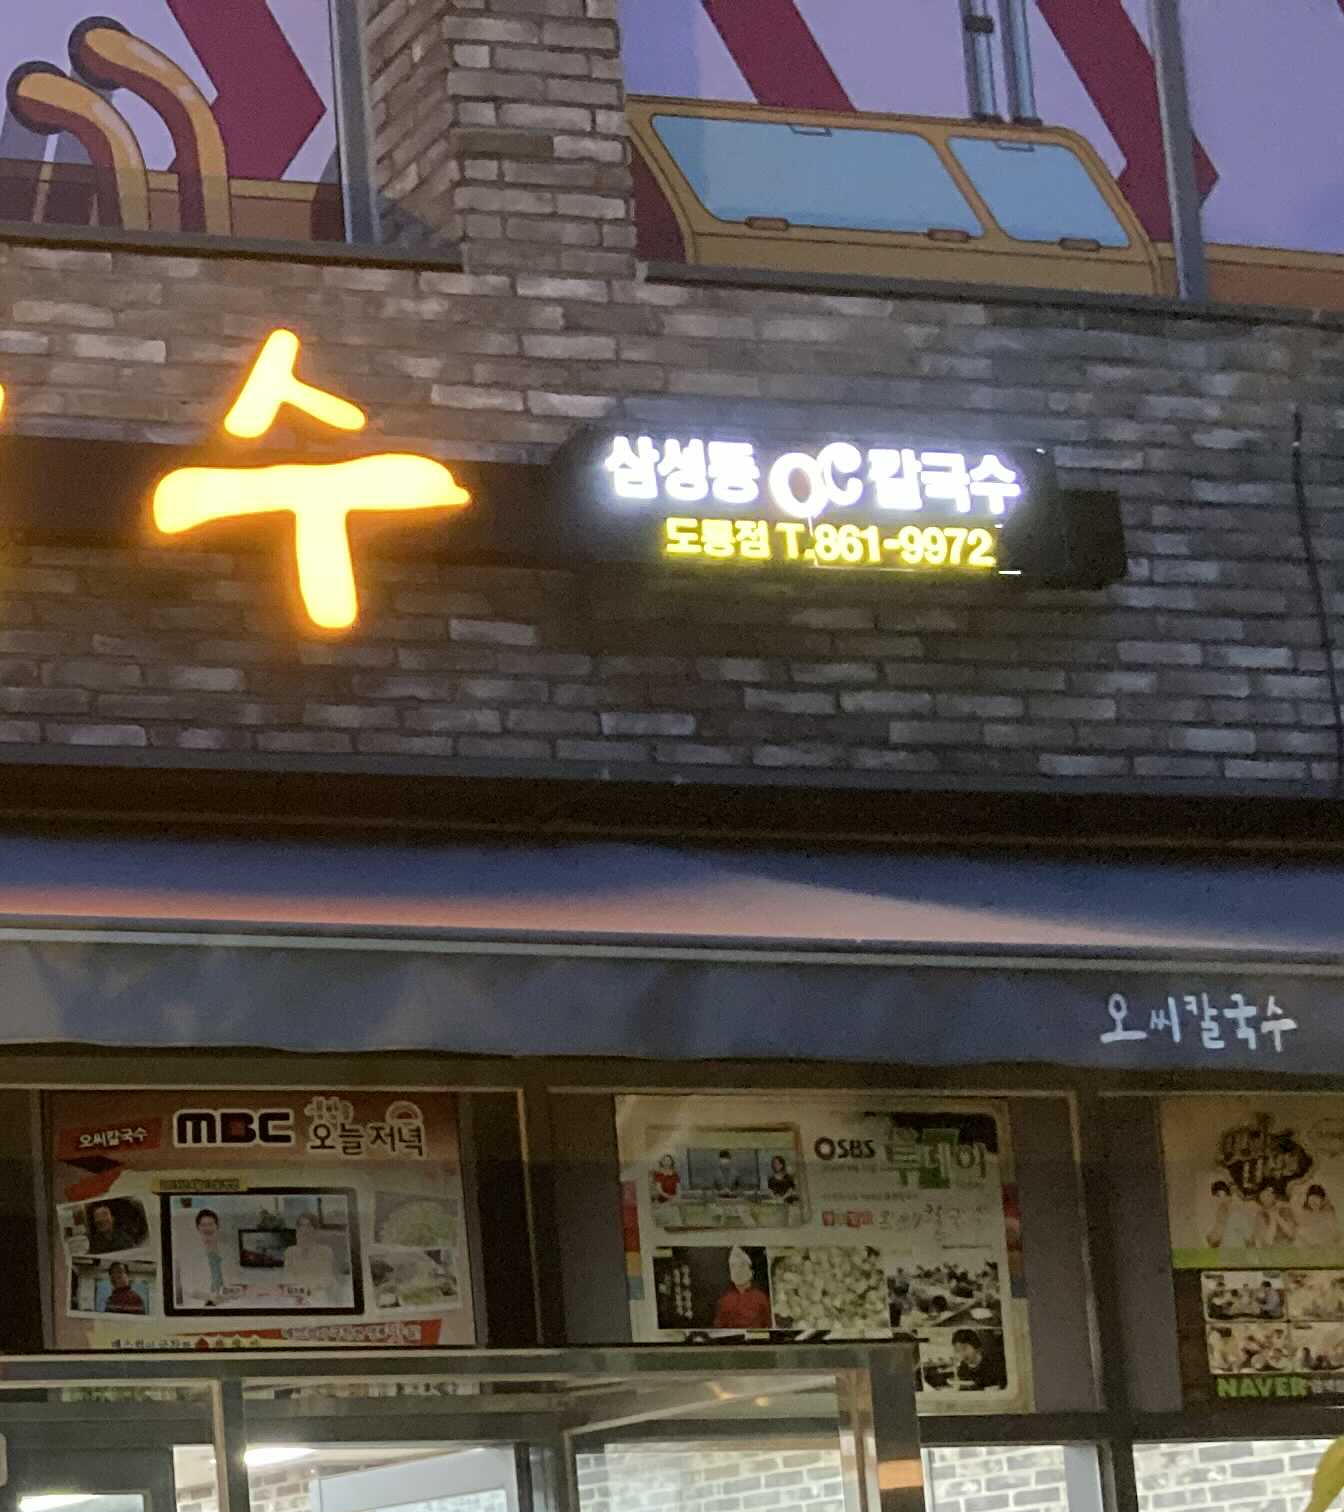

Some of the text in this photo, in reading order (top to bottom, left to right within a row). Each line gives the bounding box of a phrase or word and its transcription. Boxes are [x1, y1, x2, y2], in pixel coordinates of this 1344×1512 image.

[604, 436, 761, 504] 삼성동
[775, 522, 998, 568] T.861-9972
[1100, 992, 1298, 1053] 오씨칼국수
[175, 1110, 293, 1146] MBC
[1217, 1376, 1308, 1398] NAVER
